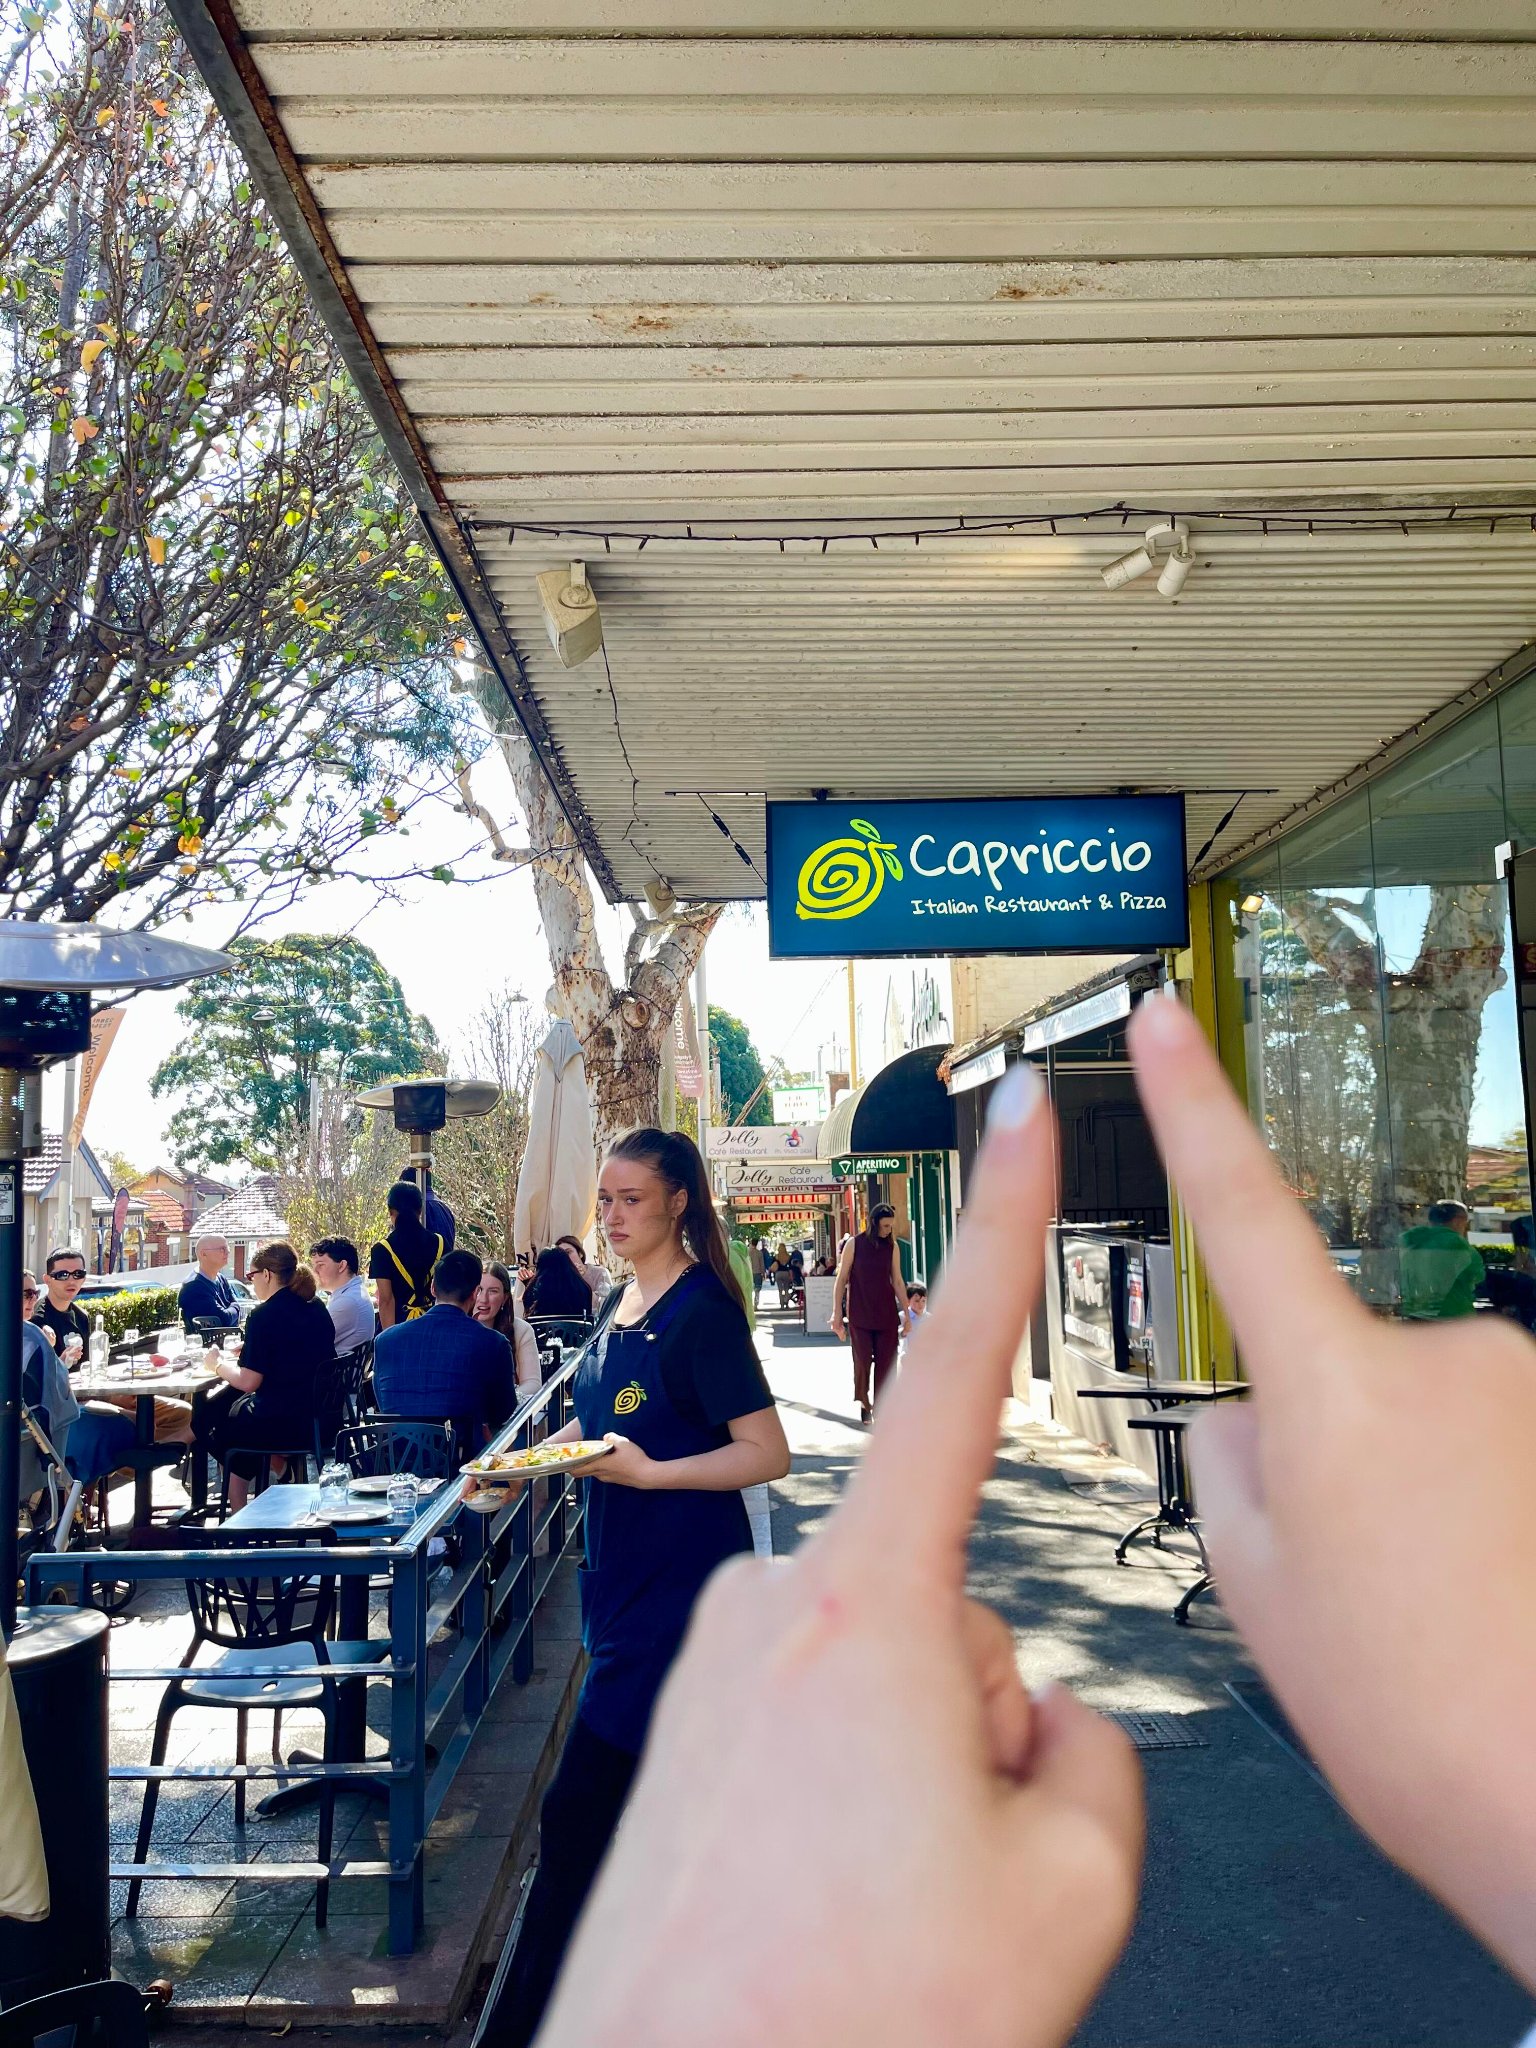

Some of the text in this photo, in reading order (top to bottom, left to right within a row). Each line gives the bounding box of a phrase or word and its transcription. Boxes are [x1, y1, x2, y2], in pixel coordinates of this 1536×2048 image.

[909, 827, 1152, 891] Capriccio
[911, 892, 1167, 916] Italian Restaurant & Pizza
[717, 1129, 761, 1148] Jolly
[729, 1147, 768, 1155] Restaurant
[856, 1158, 900, 1169] APERITIVO
[732, 1169, 774, 1186] Jolly
[778, 1175, 824, 1184] Restaurant
